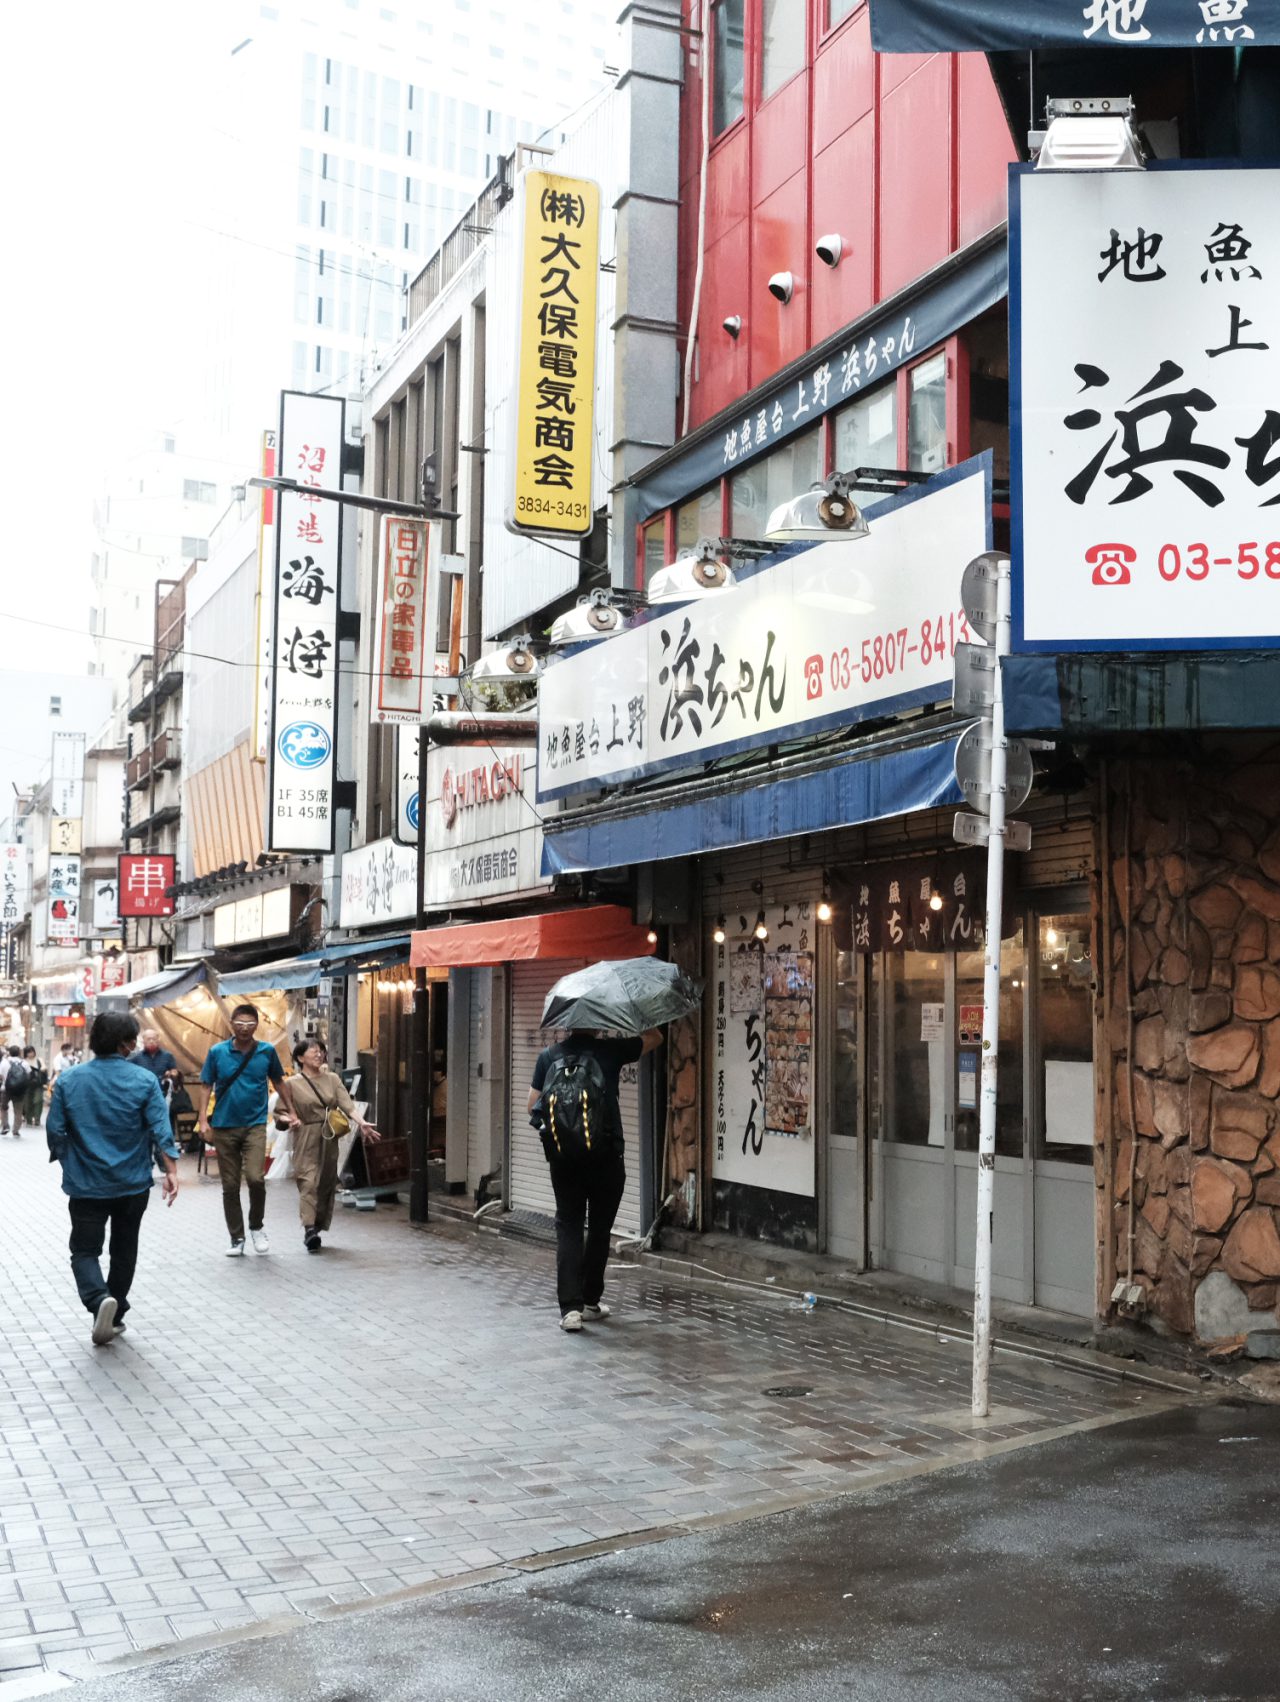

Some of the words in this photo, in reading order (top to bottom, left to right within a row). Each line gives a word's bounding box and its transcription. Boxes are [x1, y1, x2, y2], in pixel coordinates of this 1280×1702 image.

[841, 317, 917, 394] 浜ちゃん
[518, 496, 588, 519] 3834-3431
[391, 529, 417, 679] 日立の家電品
[659, 617, 788, 743] 浜ちゃん
[830, 609, 970, 691] 03-5807-8413
[387, 713, 421, 722] HITACHI
[279, 789, 293, 800] 1F
[298, 789, 329, 803] 35席
[457, 753, 524, 811] HITACHI
[278, 806, 293, 817] B1
[298, 806, 329, 819] 45席
[128, 858, 166, 897] 串
[855, 904, 972, 947] 浜ちゃん
